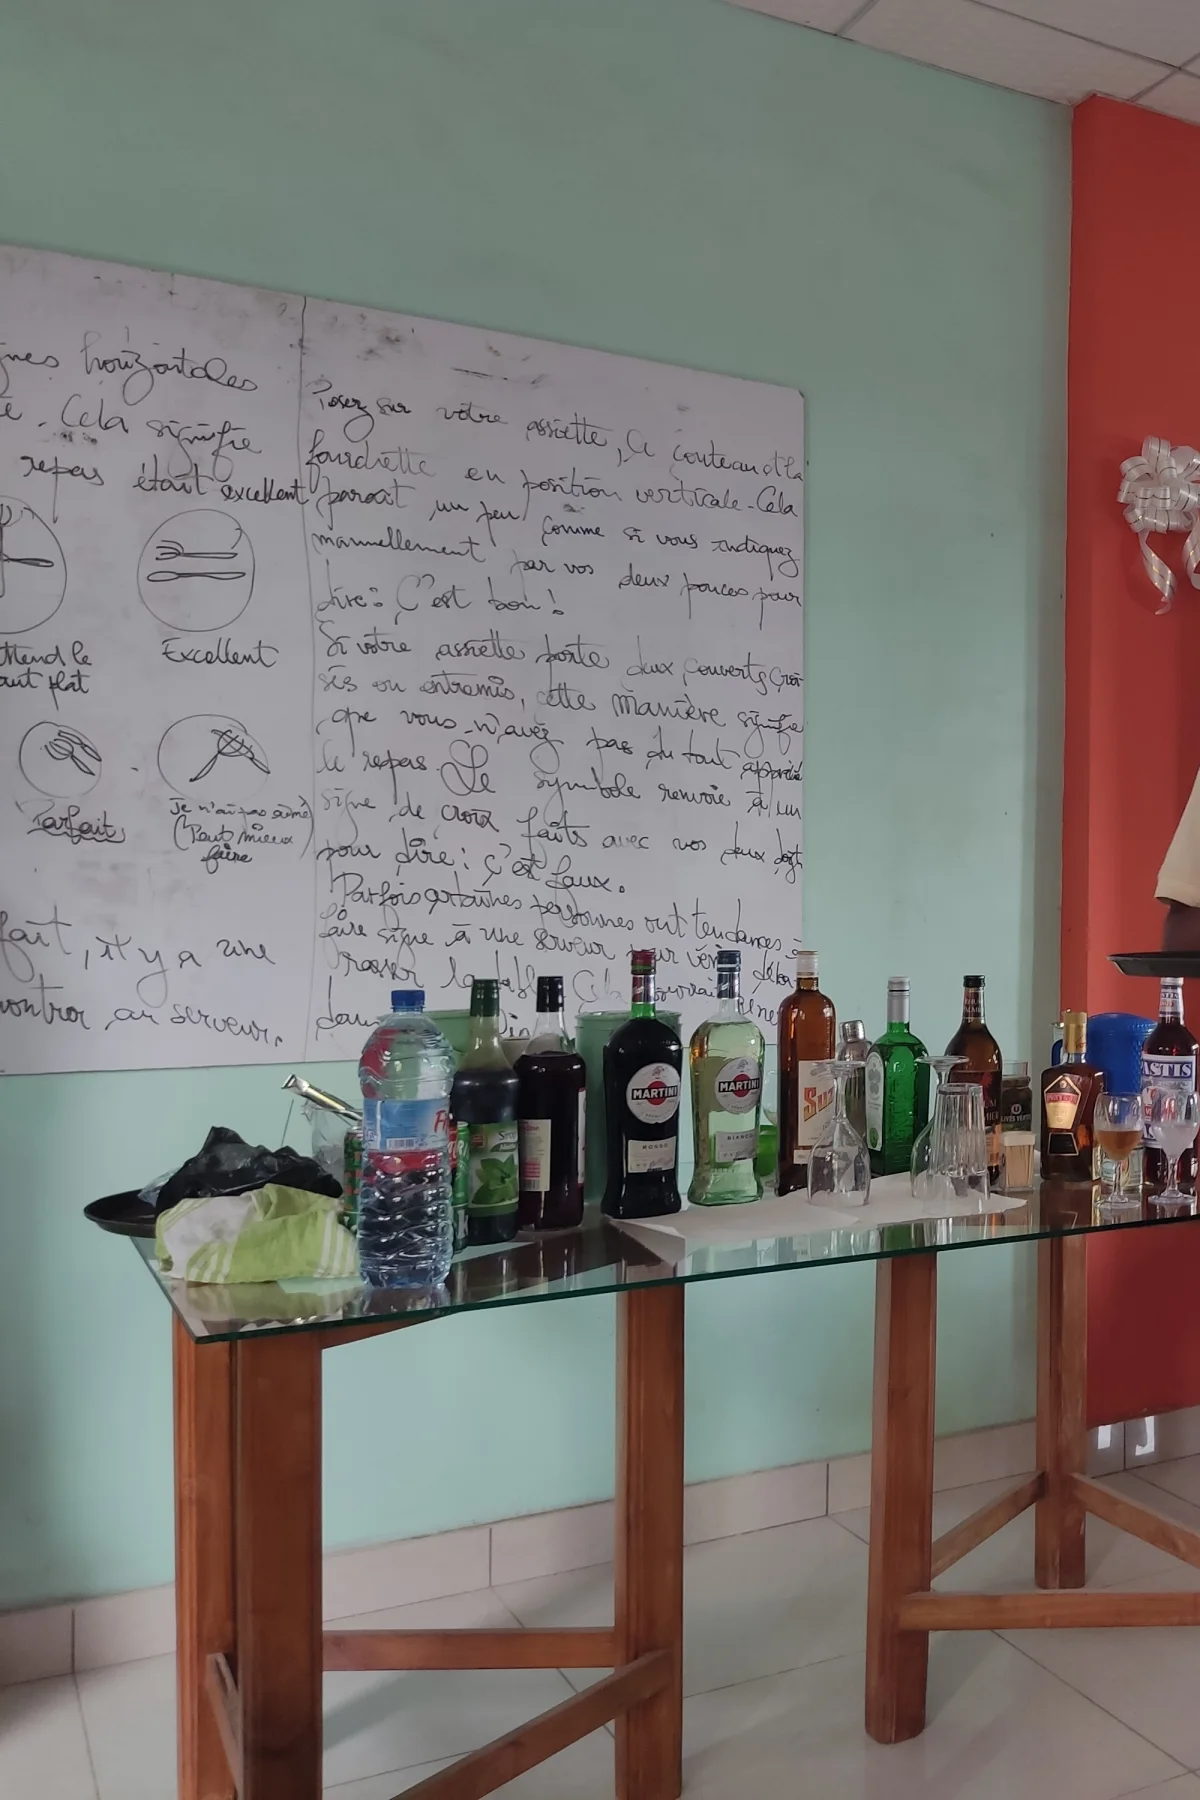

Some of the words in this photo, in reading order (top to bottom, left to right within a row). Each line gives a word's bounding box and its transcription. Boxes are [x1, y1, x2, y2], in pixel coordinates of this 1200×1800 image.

[80, 326, 258, 406] horizontales
[61, 393, 129, 434] Cela
[145, 419, 262, 483] signifie
[672, 440, 759, 475] couteau
[20, 454, 105, 524] repas
[220, 476, 310, 505] excellent
[464, 467, 505, 484] en
[520, 467, 622, 521] position
[756, 484, 799, 518] Cela
[475, 500, 520, 547] peu
[656, 533, 698, 549] vous
[510, 549, 556, 601] par
[563, 562, 595, 575] vos
[618, 562, 670, 590] deux
[679, 572, 750, 620] pouces
[751, 587, 802, 631] pour
[71, 640, 93, 666] le
[161, 636, 280, 668] Excellent
[315, 706, 377, 757] que
[399, 709, 457, 730] vous
[585, 726, 634, 786] pas
[169, 797, 193, 816] Je
[440, 803, 500, 832] croix
[602, 834, 652, 850] avec
[672, 837, 708, 851] vos
[315, 839, 382, 893] pour
[179, 950, 203, 969] a
[719, 1079, 760, 1092] MARTINI
[1142, 1062, 1192, 1078] ASTIS
[633, 1086, 678, 1099] MARTINI
[803, 1086, 835, 1123] Suz
[641, 1142, 669, 1150] ROSSO
[726, 1133, 755, 1141] BIANCO
